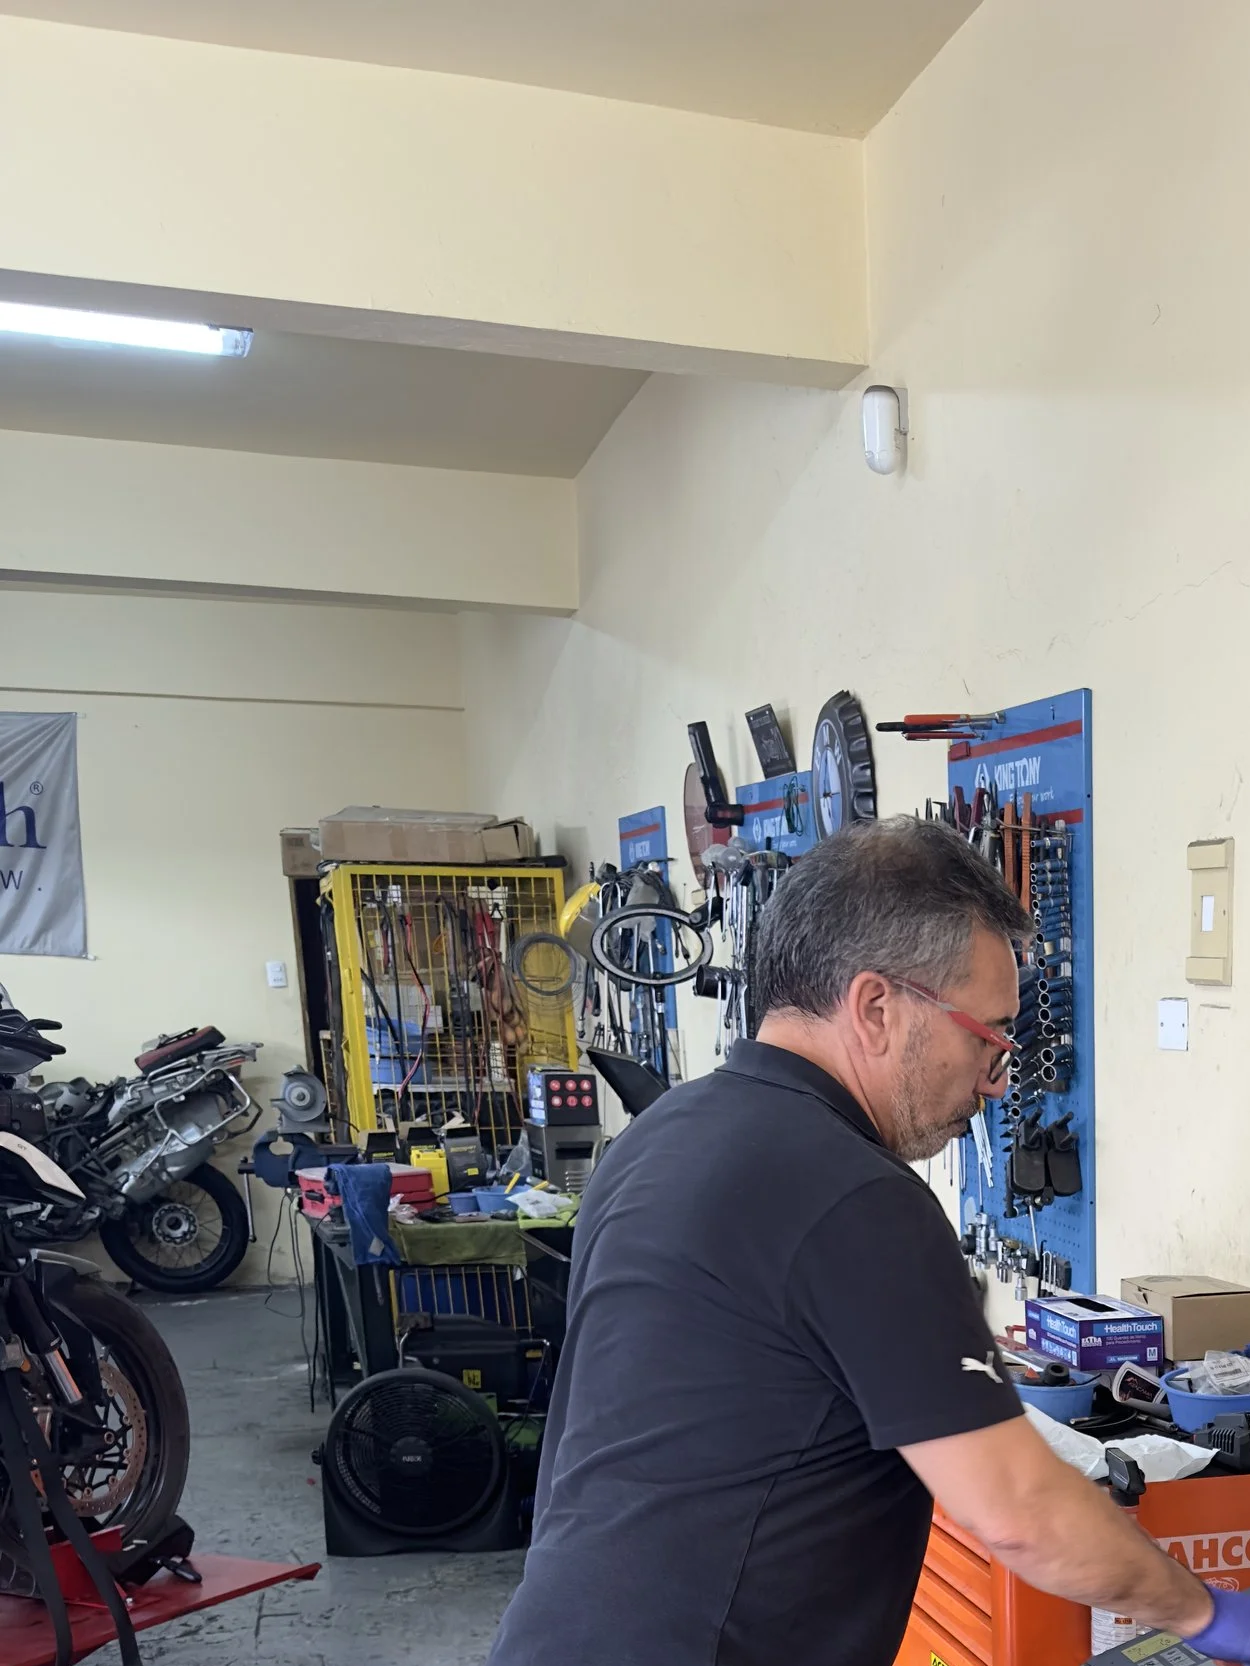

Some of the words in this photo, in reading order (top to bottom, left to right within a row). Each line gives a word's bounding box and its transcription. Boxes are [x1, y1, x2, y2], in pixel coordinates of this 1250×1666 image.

[995, 762, 1015, 791] KING
[1015, 756, 1041, 788] TONY
[1104, 1322, 1157, 1334] HealthTouch
[1148, 1348, 1157, 1358] M
